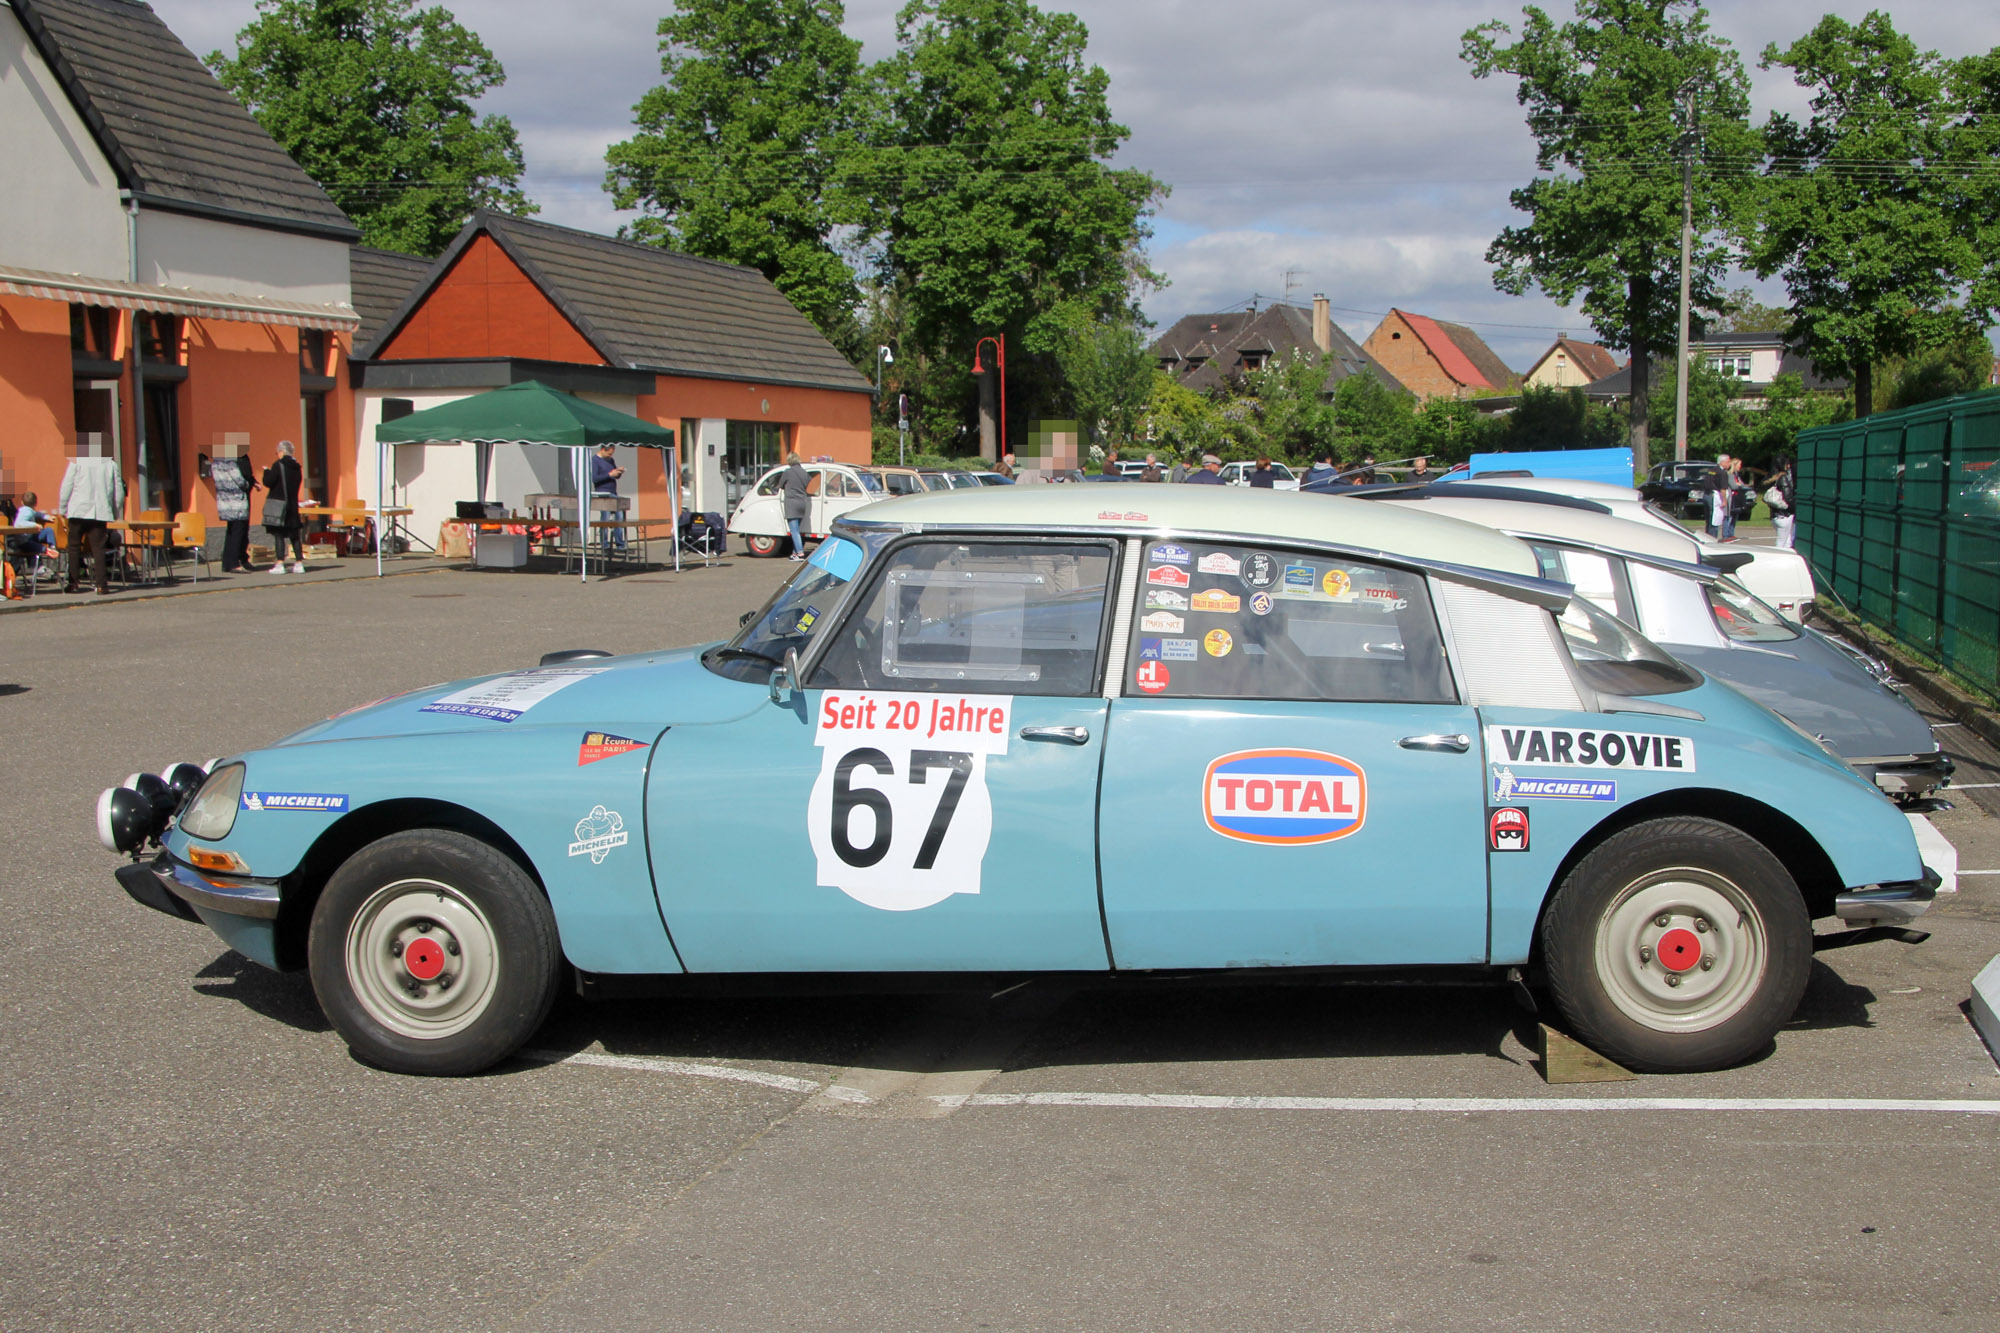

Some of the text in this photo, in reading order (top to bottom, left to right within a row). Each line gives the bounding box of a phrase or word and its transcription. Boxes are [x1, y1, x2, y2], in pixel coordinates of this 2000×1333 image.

[1365, 588, 1399, 599] TOTAL
[1145, 620, 1180, 629] PARIS NICE
[1140, 648, 1159, 658] AXA
[822, 695, 1005, 739] Seit 20 Jahre
[1501, 728, 1683, 768] VARSOVIE
[1217, 778, 1353, 813] TOTAL
[1517, 781, 1613, 796] MICHELIN
[265, 795, 344, 808] MICHELIN
[830, 747, 974, 870] 67
[571, 834, 625, 854] MICHELIN
